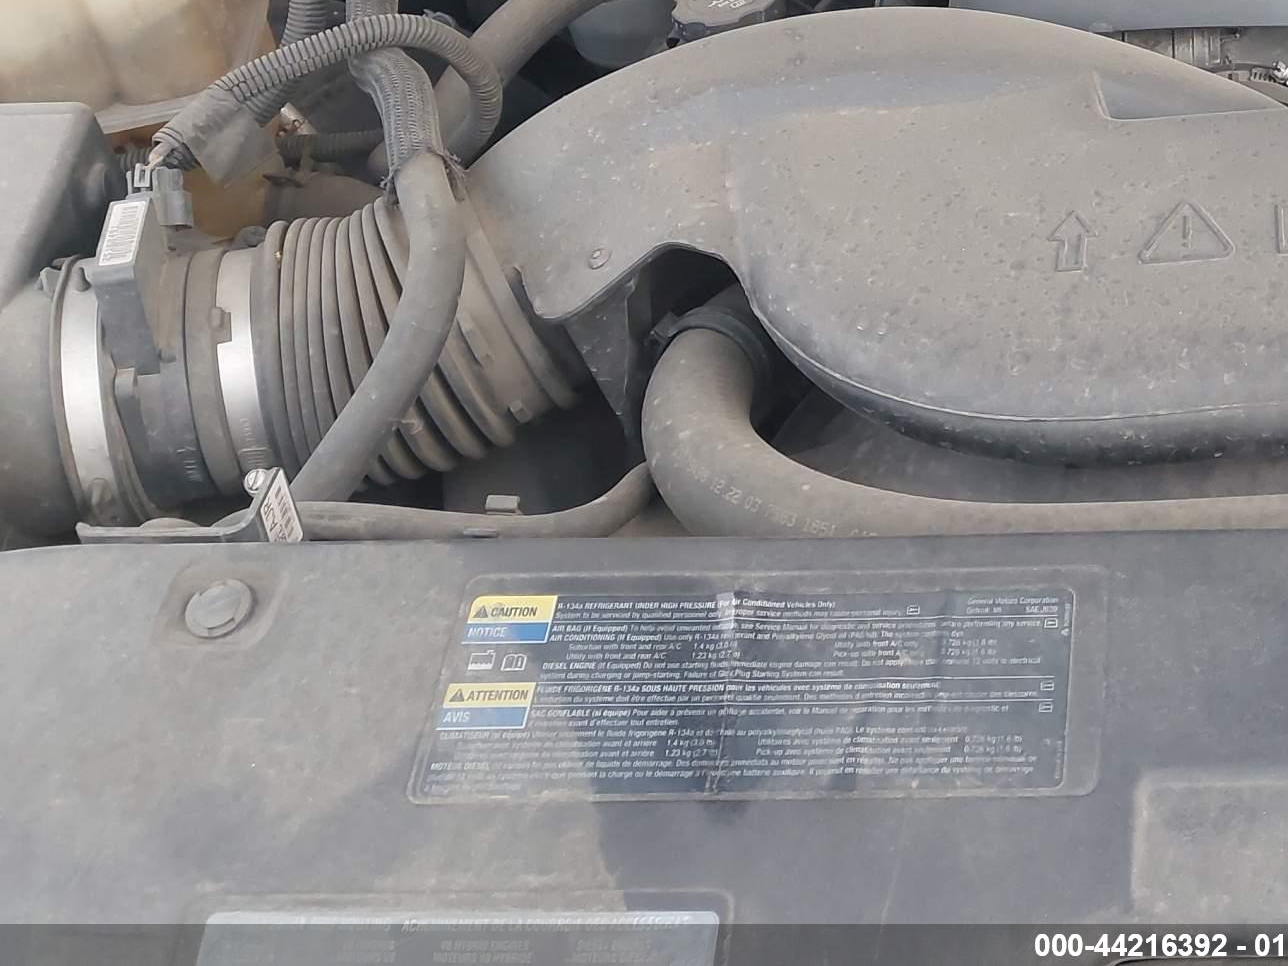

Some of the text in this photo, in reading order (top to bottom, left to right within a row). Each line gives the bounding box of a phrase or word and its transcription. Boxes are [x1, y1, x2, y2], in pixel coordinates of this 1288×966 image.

[742, 598, 786, 608] Conditioned
[787, 601, 816, 609] Vehicles
[817, 600, 836, 609] Only)
[967, 596, 1059, 605] General Motors Corporation
[490, 606, 538, 617] CAUTION
[467, 626, 508, 638] NOTICE
[592, 624, 628, 632] Equipped)
[549, 634, 562, 642] AIR
[563, 634, 616, 642] CONDITIONING
[626, 634, 662, 642] Equipped)
[606, 662, 642, 670] Equipped)
[613, 685, 640, 693] R-134a
[641, 684, 662, 693] SOUS
[662, 684, 688, 693] HAUTE
[688, 684, 725, 692] PRESSION
[725, 684, 743, 692] pour
[744, 684, 756, 692] les
[467, 689, 529, 701] ATTENTION
[442, 711, 470, 723] AVIS
[547, 709, 591, 717] GONFLABLE
